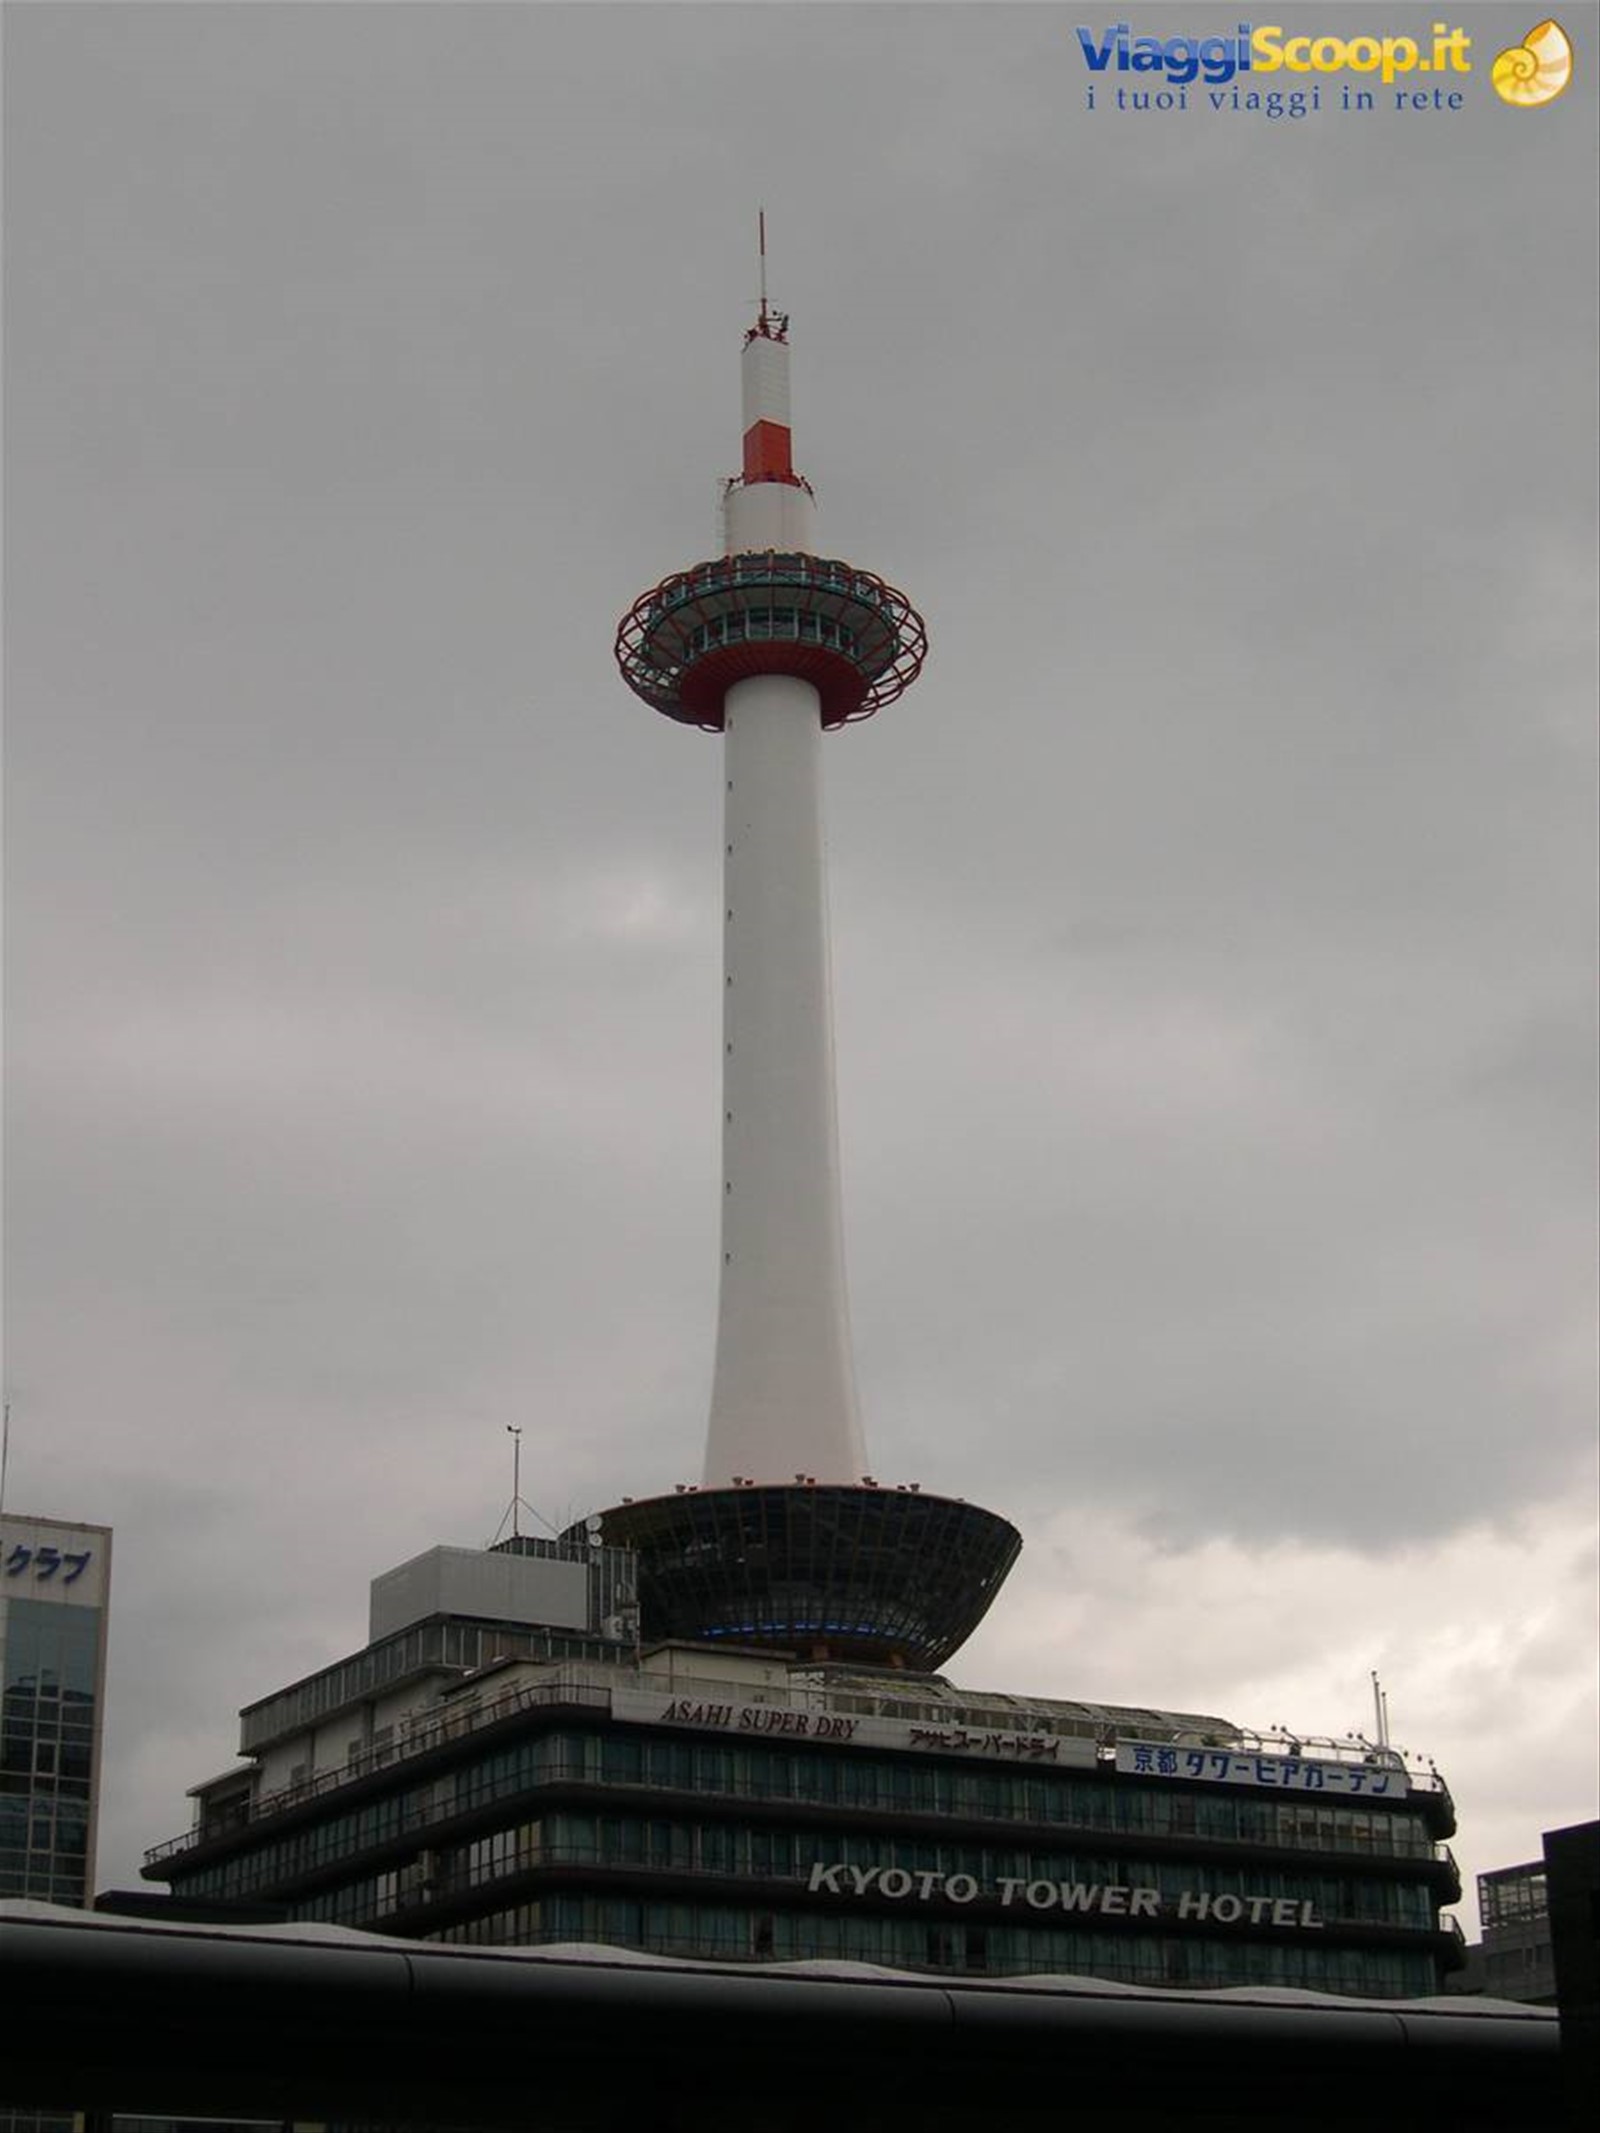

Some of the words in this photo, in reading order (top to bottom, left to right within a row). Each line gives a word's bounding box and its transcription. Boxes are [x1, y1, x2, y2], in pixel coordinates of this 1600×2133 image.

[661, 1702, 733, 1726] ASAHI
[739, 1708, 809, 1734] SUPER
[812, 1715, 860, 1739] DRY
[807, 1861, 978, 1902] KYOTO
[995, 1876, 1159, 1917] TOWER
[1177, 1890, 1325, 1928] HOTEL
